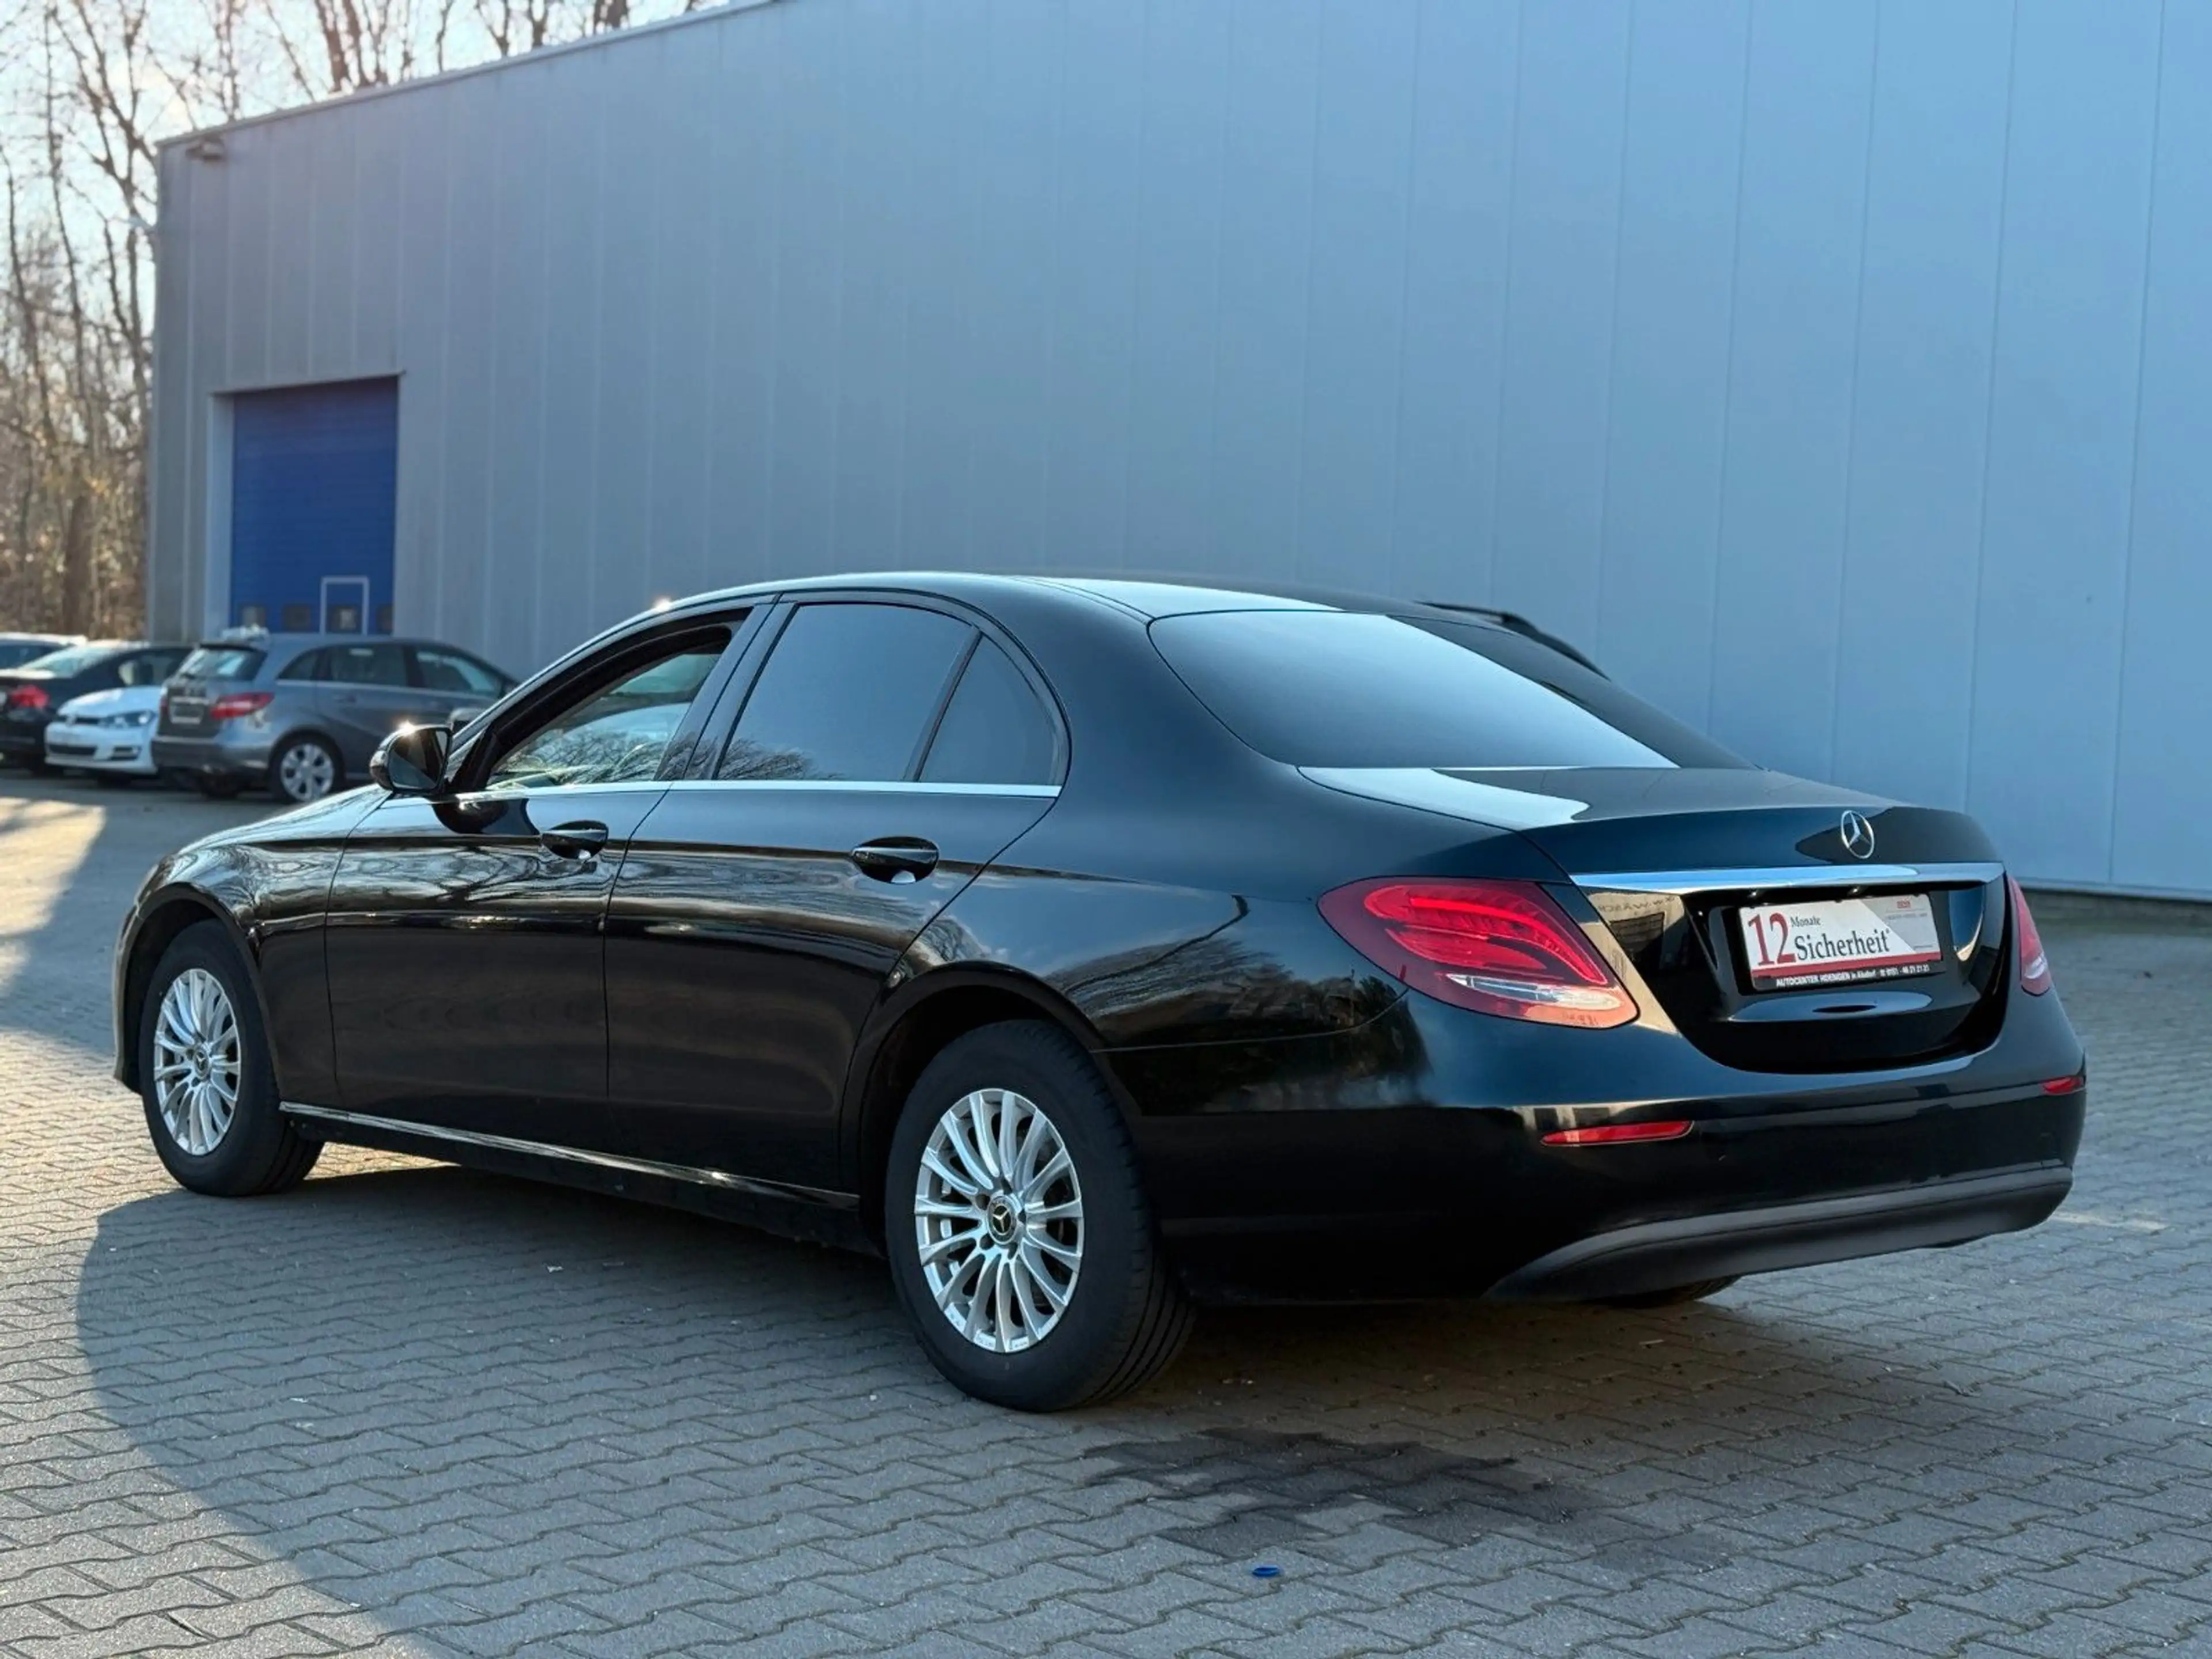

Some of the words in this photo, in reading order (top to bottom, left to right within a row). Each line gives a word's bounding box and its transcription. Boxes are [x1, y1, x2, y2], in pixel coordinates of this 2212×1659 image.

[1790, 916, 1821, 927] Monate
[1748, 912, 1796, 966] 12
[1794, 927, 1890, 961] Sicherheit
